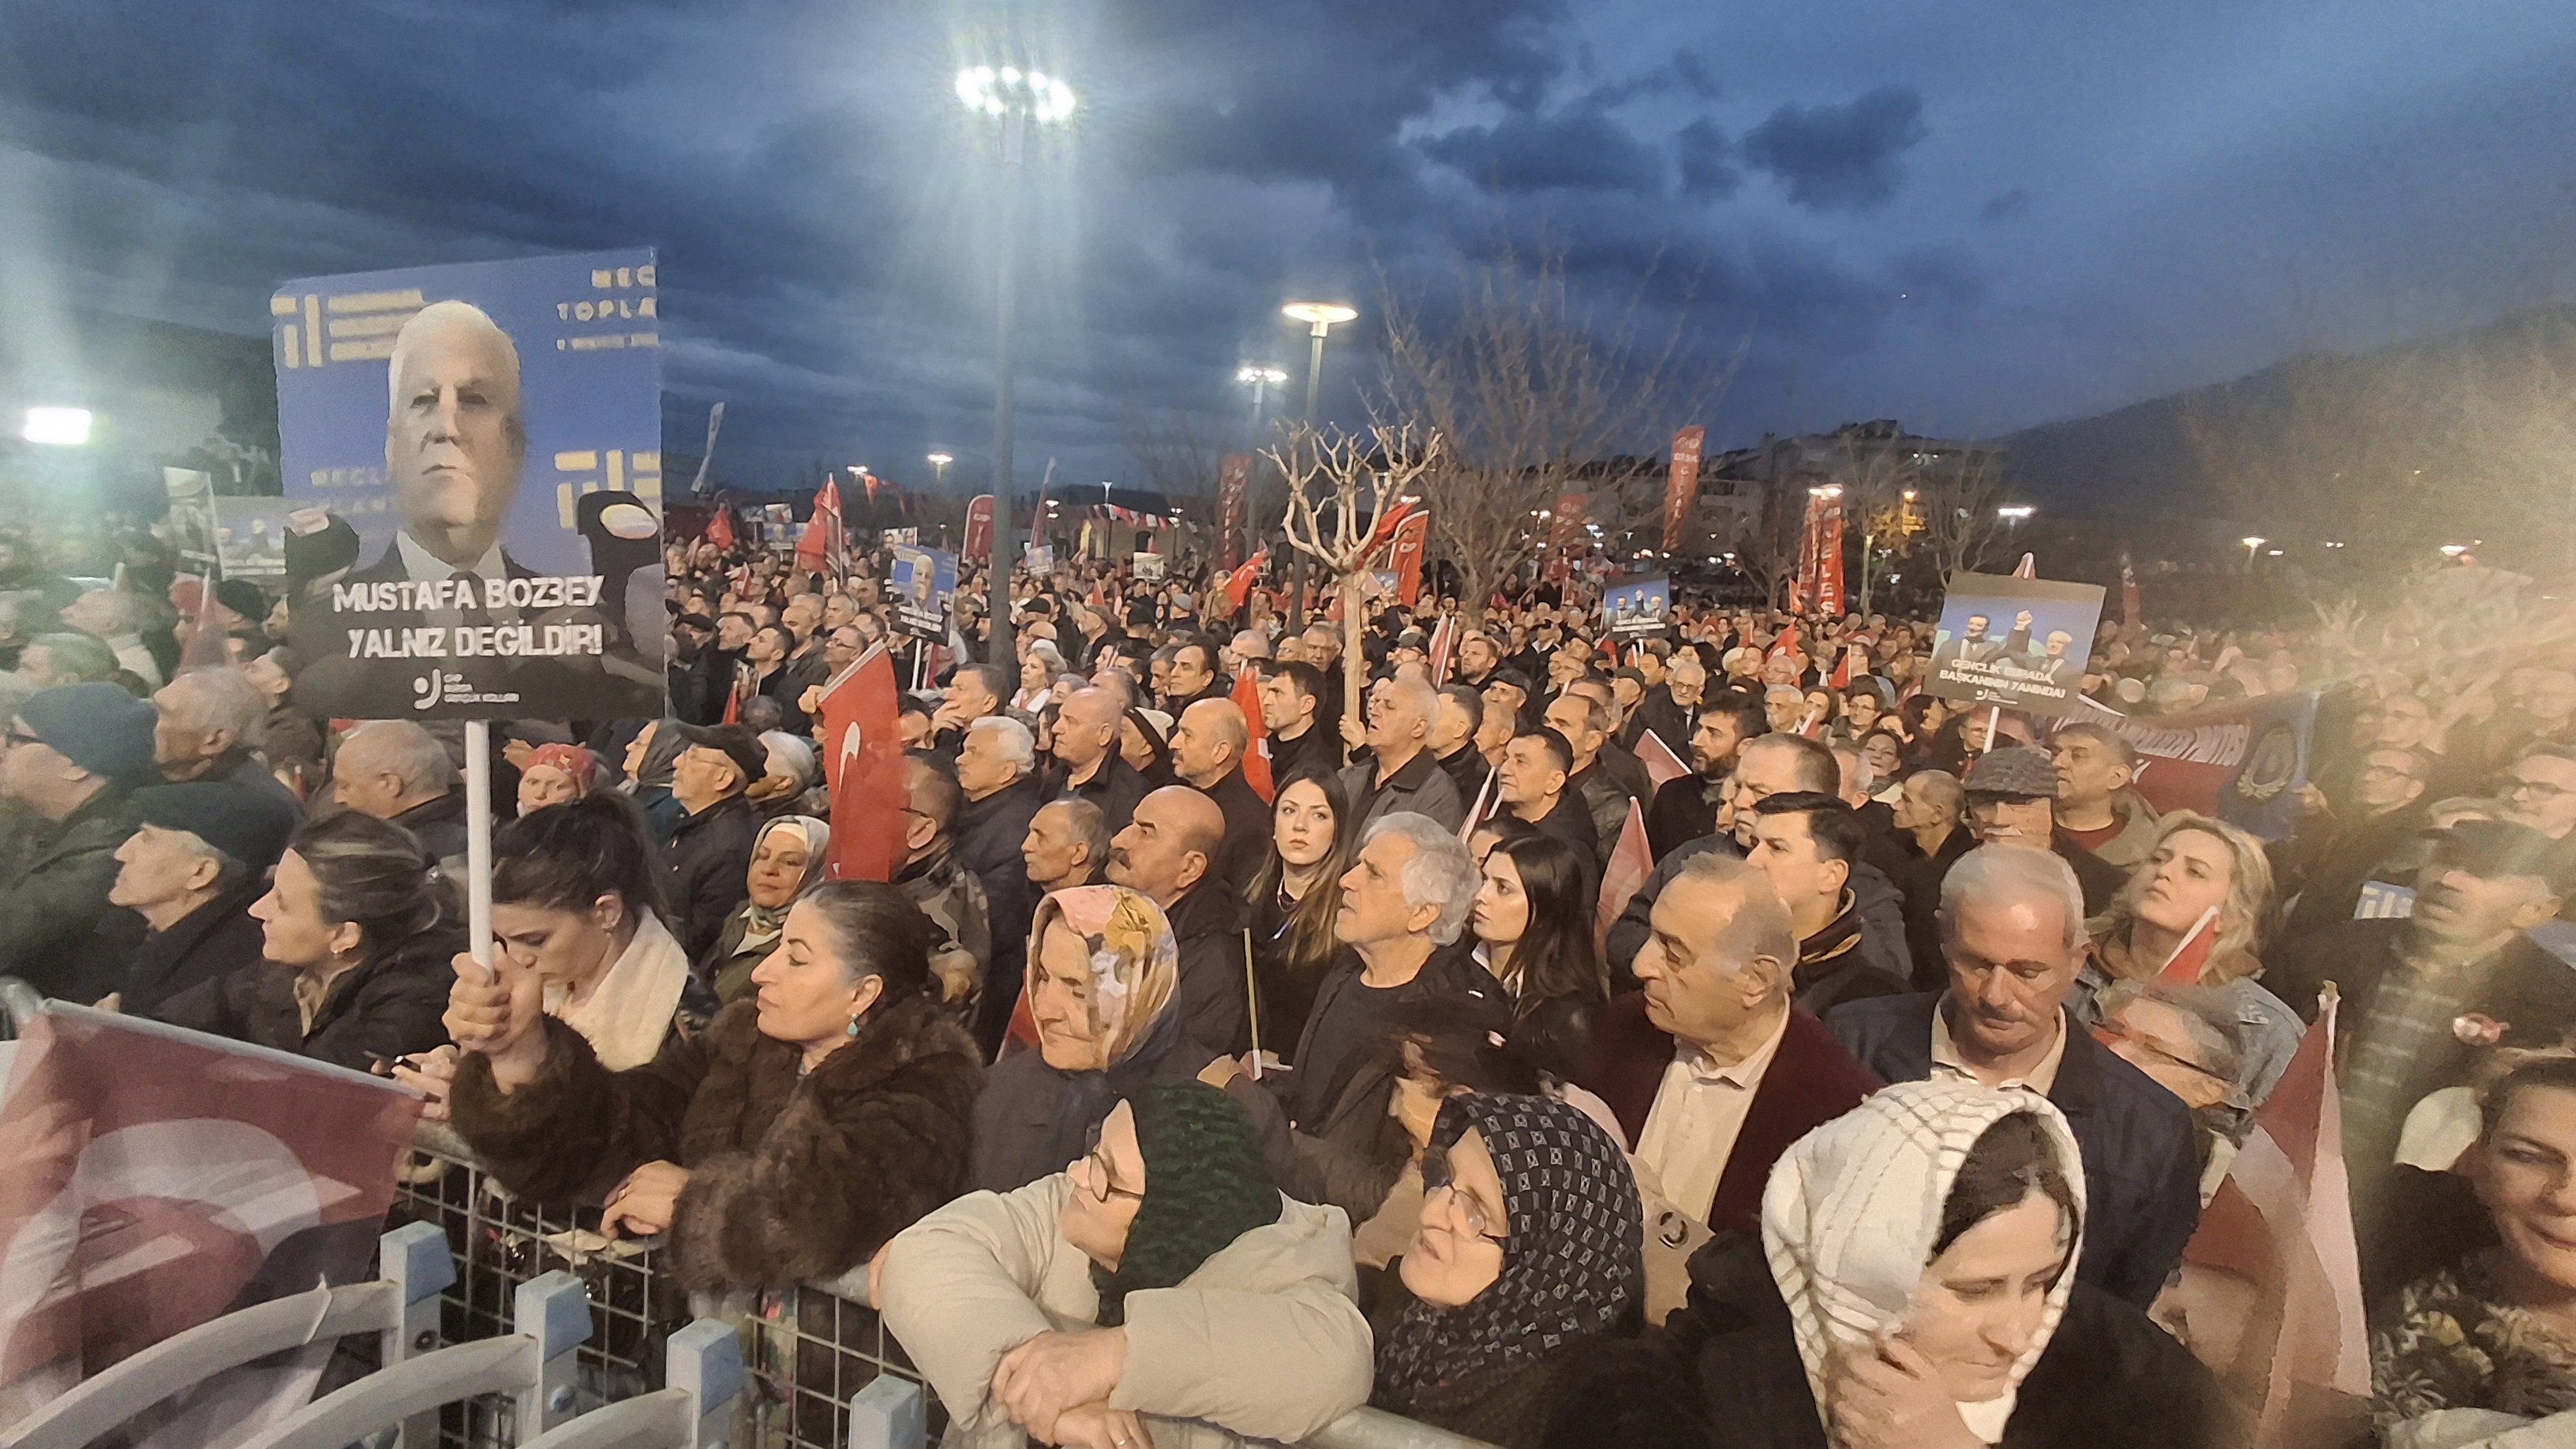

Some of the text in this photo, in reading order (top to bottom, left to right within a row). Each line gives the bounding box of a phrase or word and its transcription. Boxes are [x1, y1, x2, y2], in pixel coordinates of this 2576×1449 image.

[332, 575, 605, 612] MUSTAFA BOZBEY
[455, 619, 603, 657] DEĞİLDİR!
